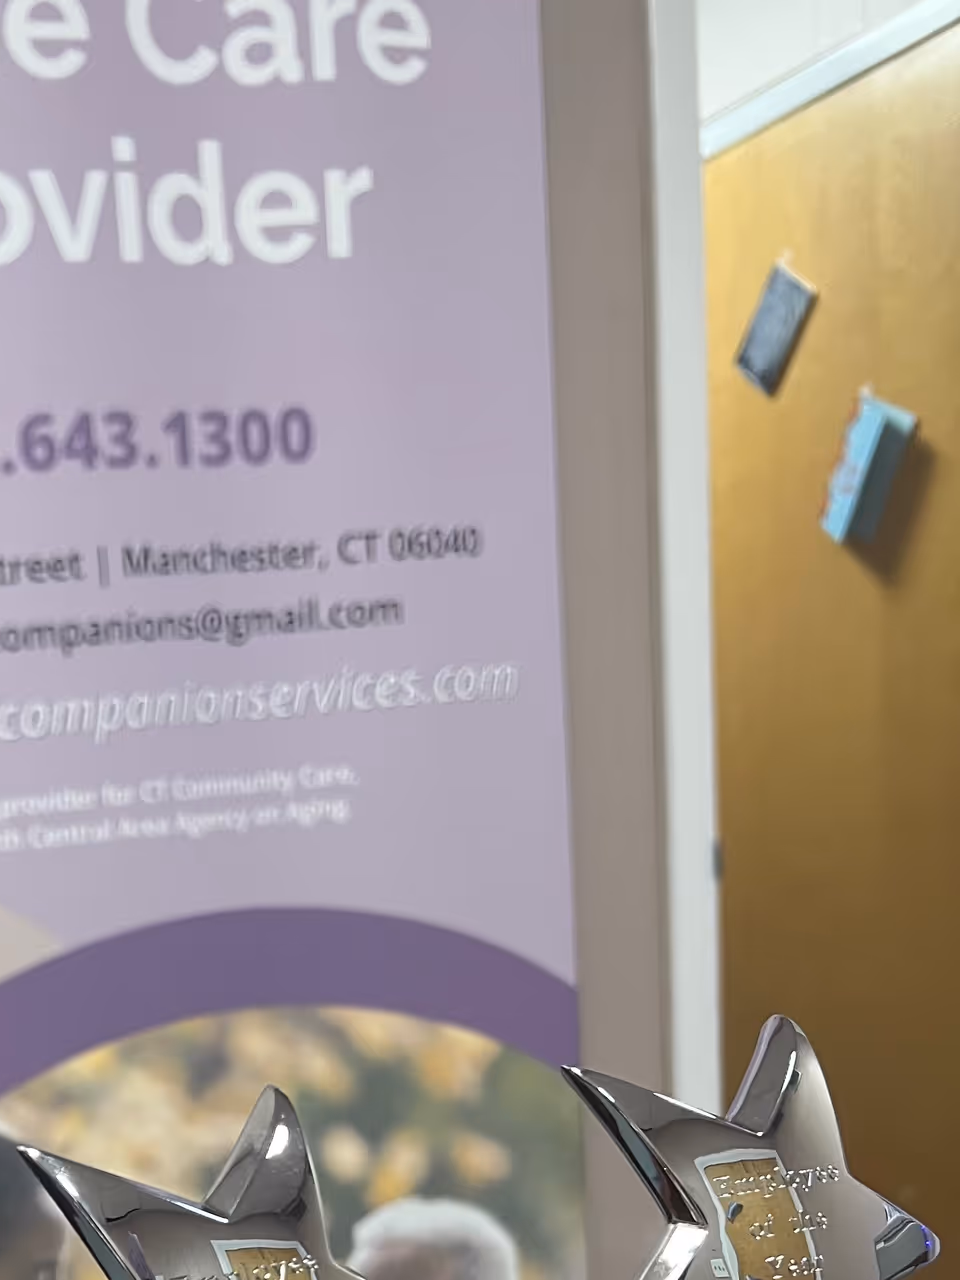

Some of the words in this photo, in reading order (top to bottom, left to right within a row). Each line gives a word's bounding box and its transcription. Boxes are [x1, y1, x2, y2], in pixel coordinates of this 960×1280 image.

[126, 0, 432, 85] Care
[122, 539, 329, 578] Manchester,
[338, 528, 381, 565] CT
[388, 525, 483, 562] 06040
[101, 780, 134, 806] for
[139, 776, 168, 803] CT
[171, 768, 292, 800] Community
[26, 817, 109, 850] Central
[176, 809, 249, 839] Agency
